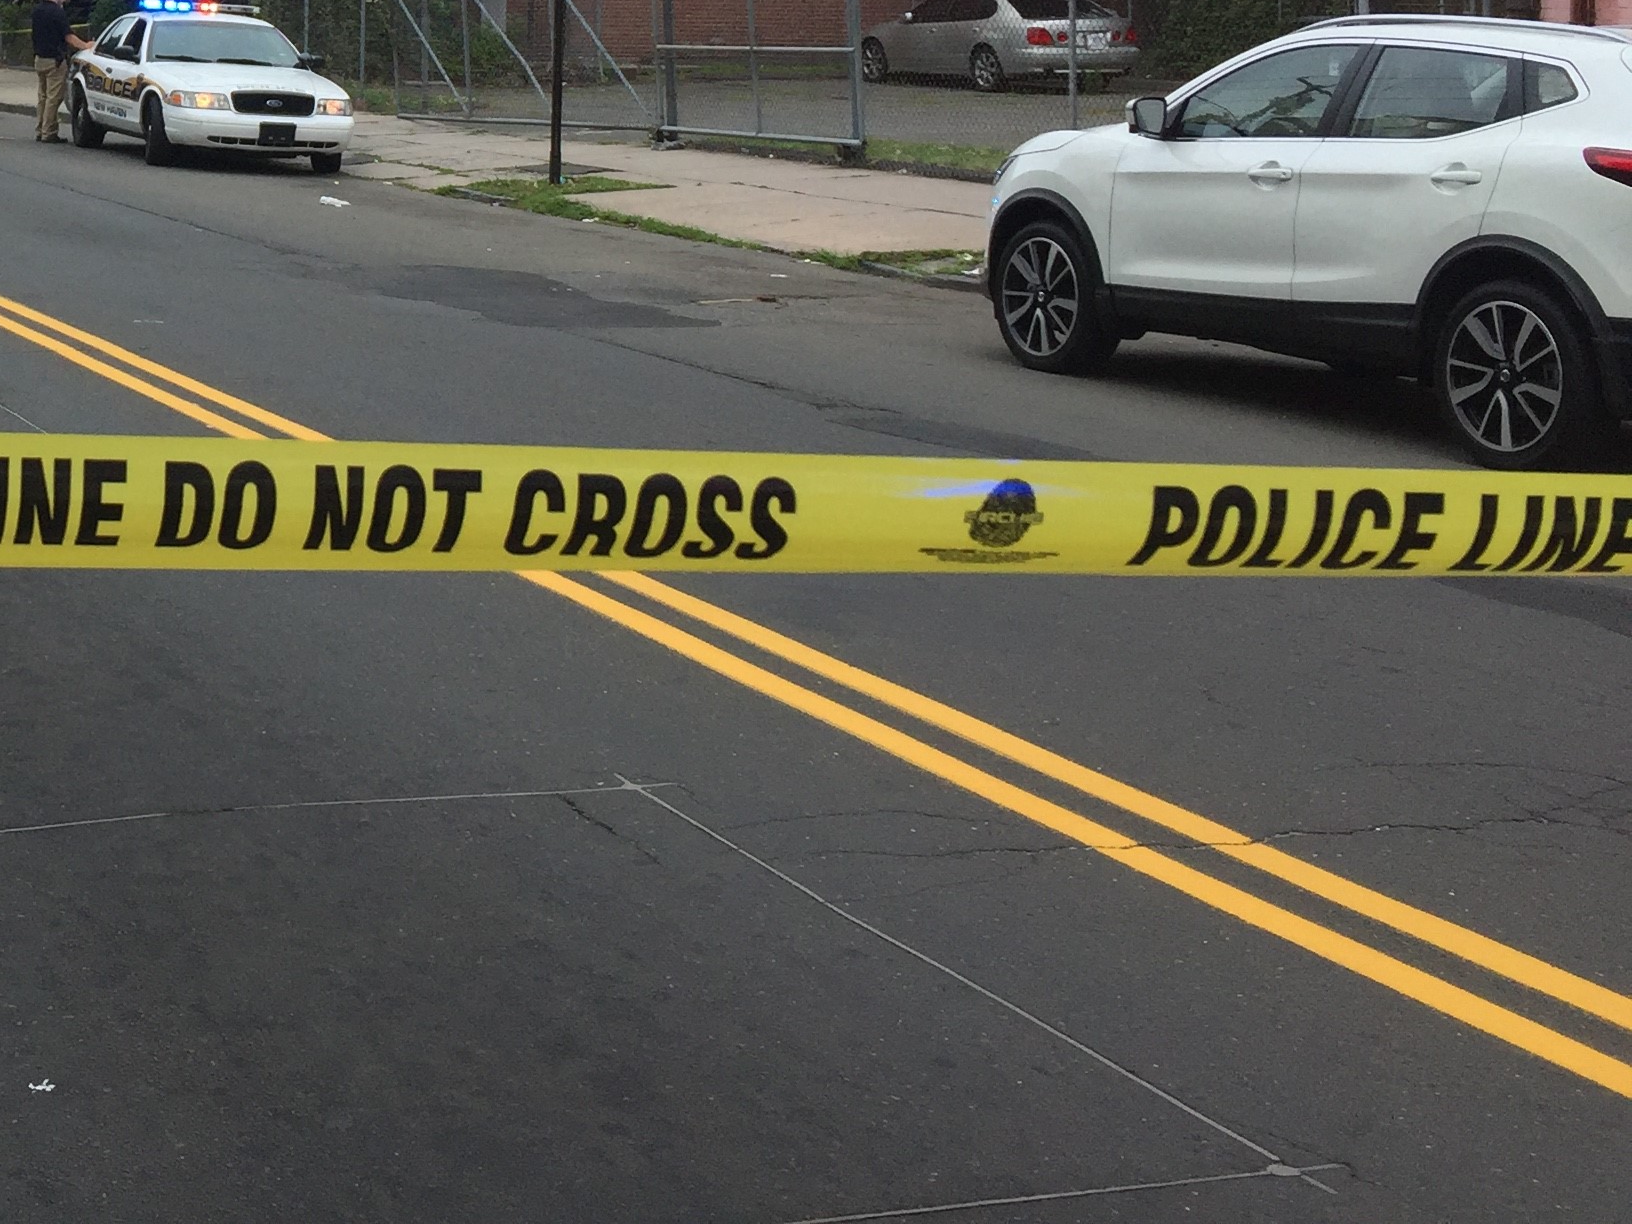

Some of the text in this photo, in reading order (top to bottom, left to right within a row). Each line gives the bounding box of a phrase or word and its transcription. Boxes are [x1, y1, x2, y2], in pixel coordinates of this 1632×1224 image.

[155, 460, 277, 550] DO
[303, 465, 483, 554] NOT
[503, 469, 797, 560] CROSS
[1126, 484, 1446, 571] POLICE
